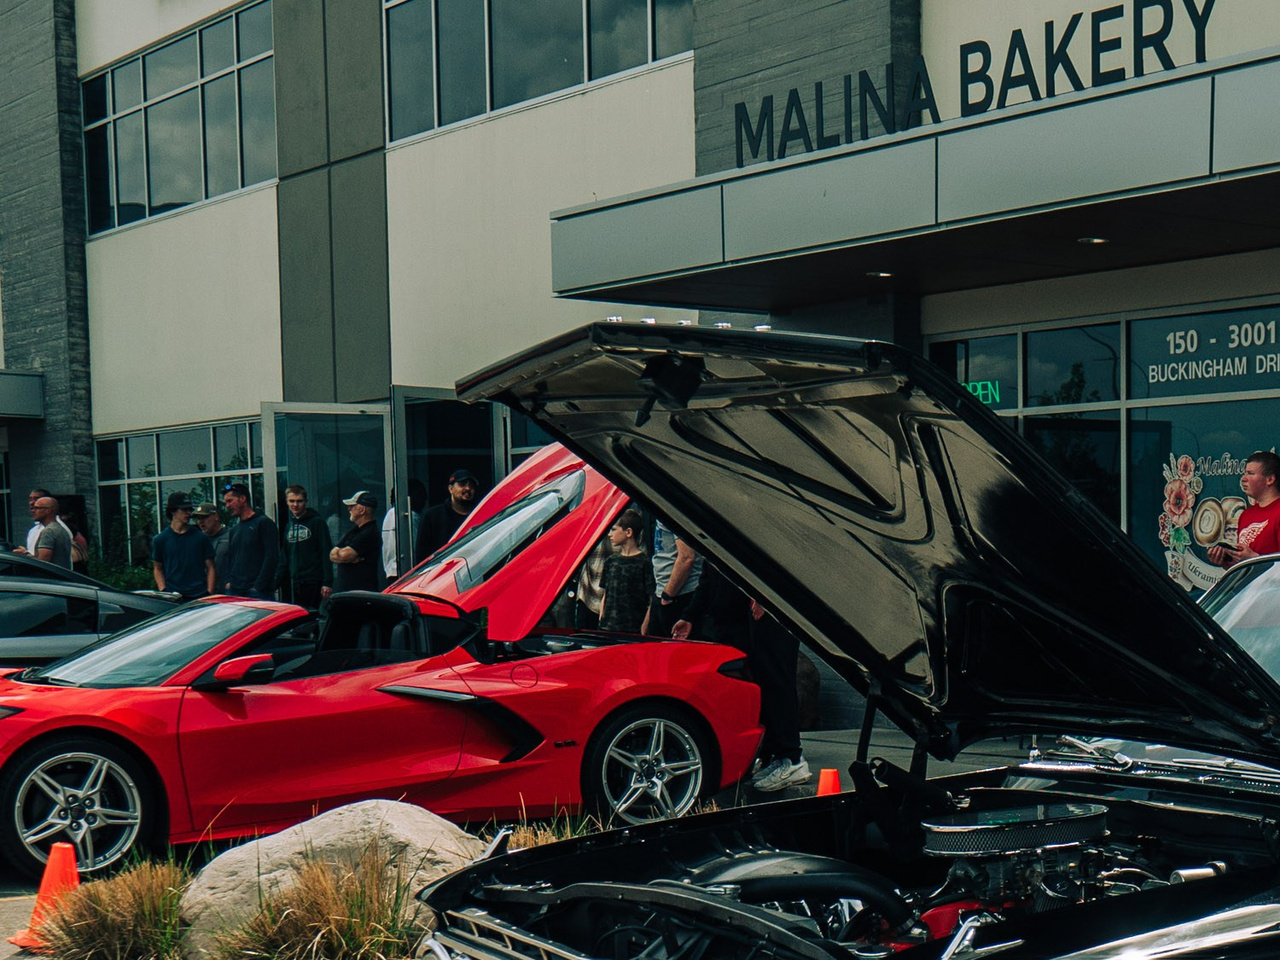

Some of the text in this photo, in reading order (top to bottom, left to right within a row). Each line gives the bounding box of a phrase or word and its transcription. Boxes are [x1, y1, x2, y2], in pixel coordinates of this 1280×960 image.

[735, 0, 1217, 168] MALINA BAKERY
[1166, 329, 1198, 355] 150
[1228, 320, 1276, 349] 3001
[1149, 357, 1247, 383] BUCKINGHAM
[1195, 452, 1248, 477] Malina
